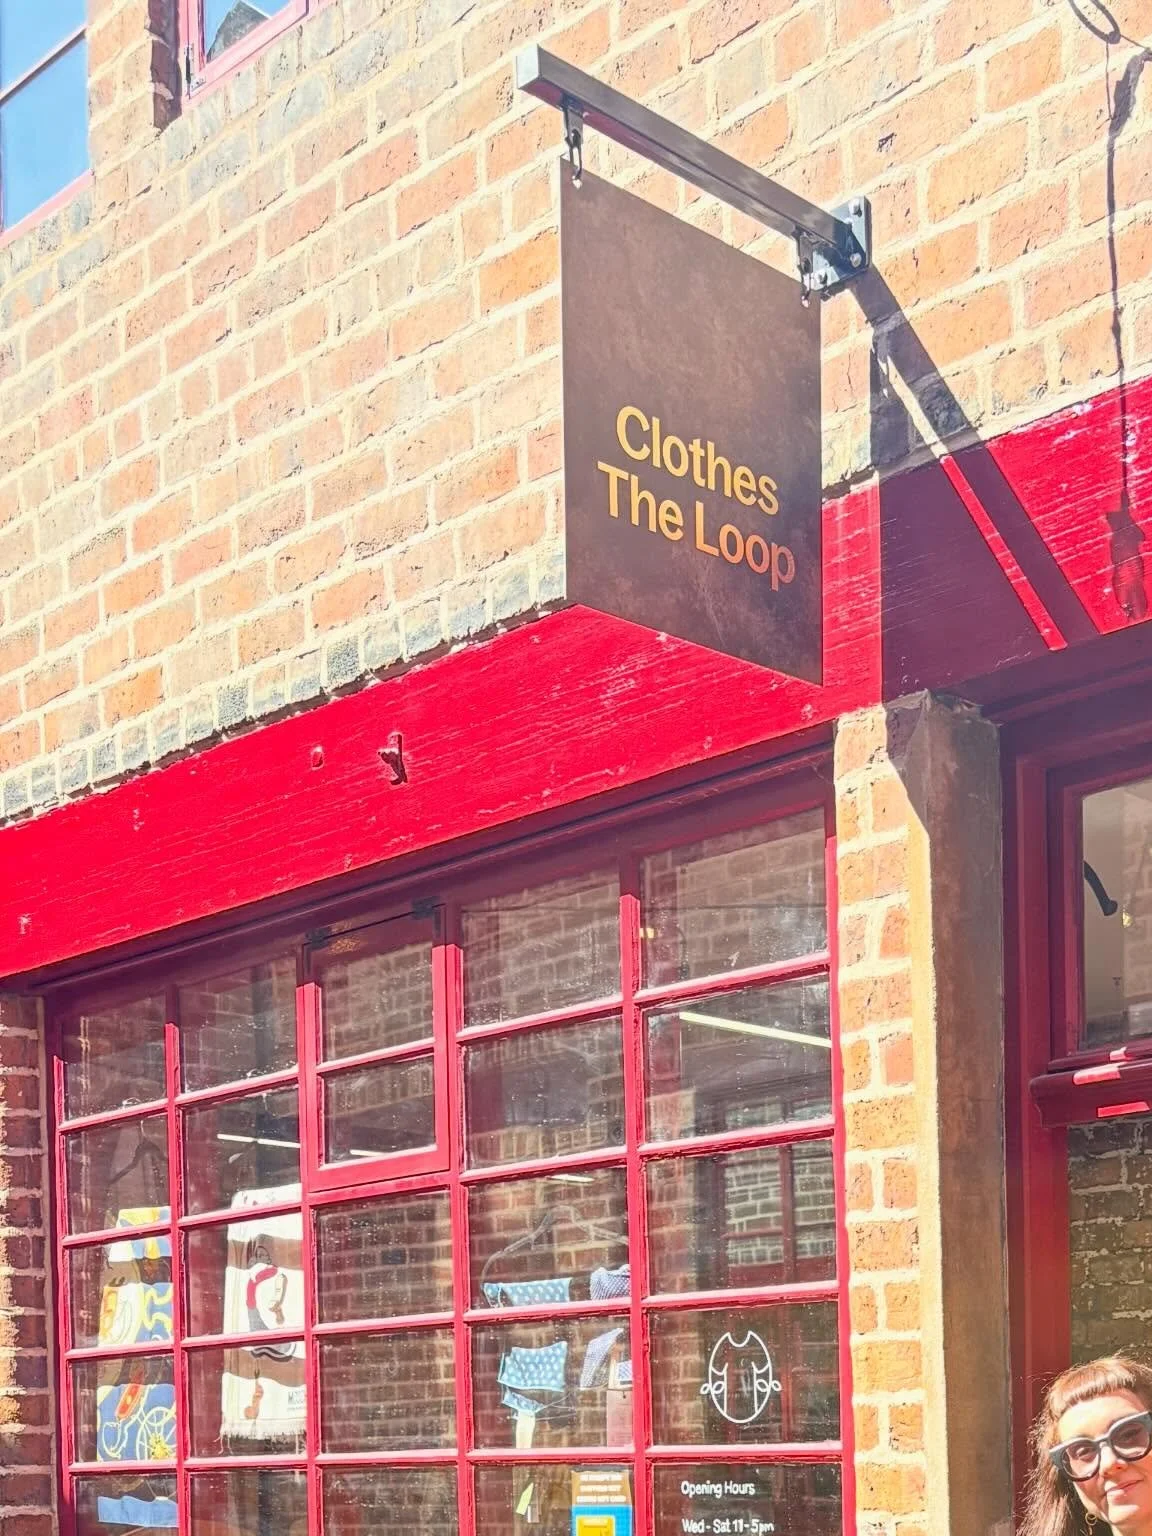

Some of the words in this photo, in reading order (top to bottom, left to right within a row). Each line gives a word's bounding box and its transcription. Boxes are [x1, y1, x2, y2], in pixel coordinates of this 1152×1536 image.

[616, 405, 779, 516] Clothes
[597, 460, 684, 541] The
[695, 500, 796, 592] Loop
[681, 1480, 722, 1498] Opening
[724, 1480, 755, 1495] Hours
[682, 1518, 704, 1533] Wed
[713, 1518, 731, 1533] Sat
